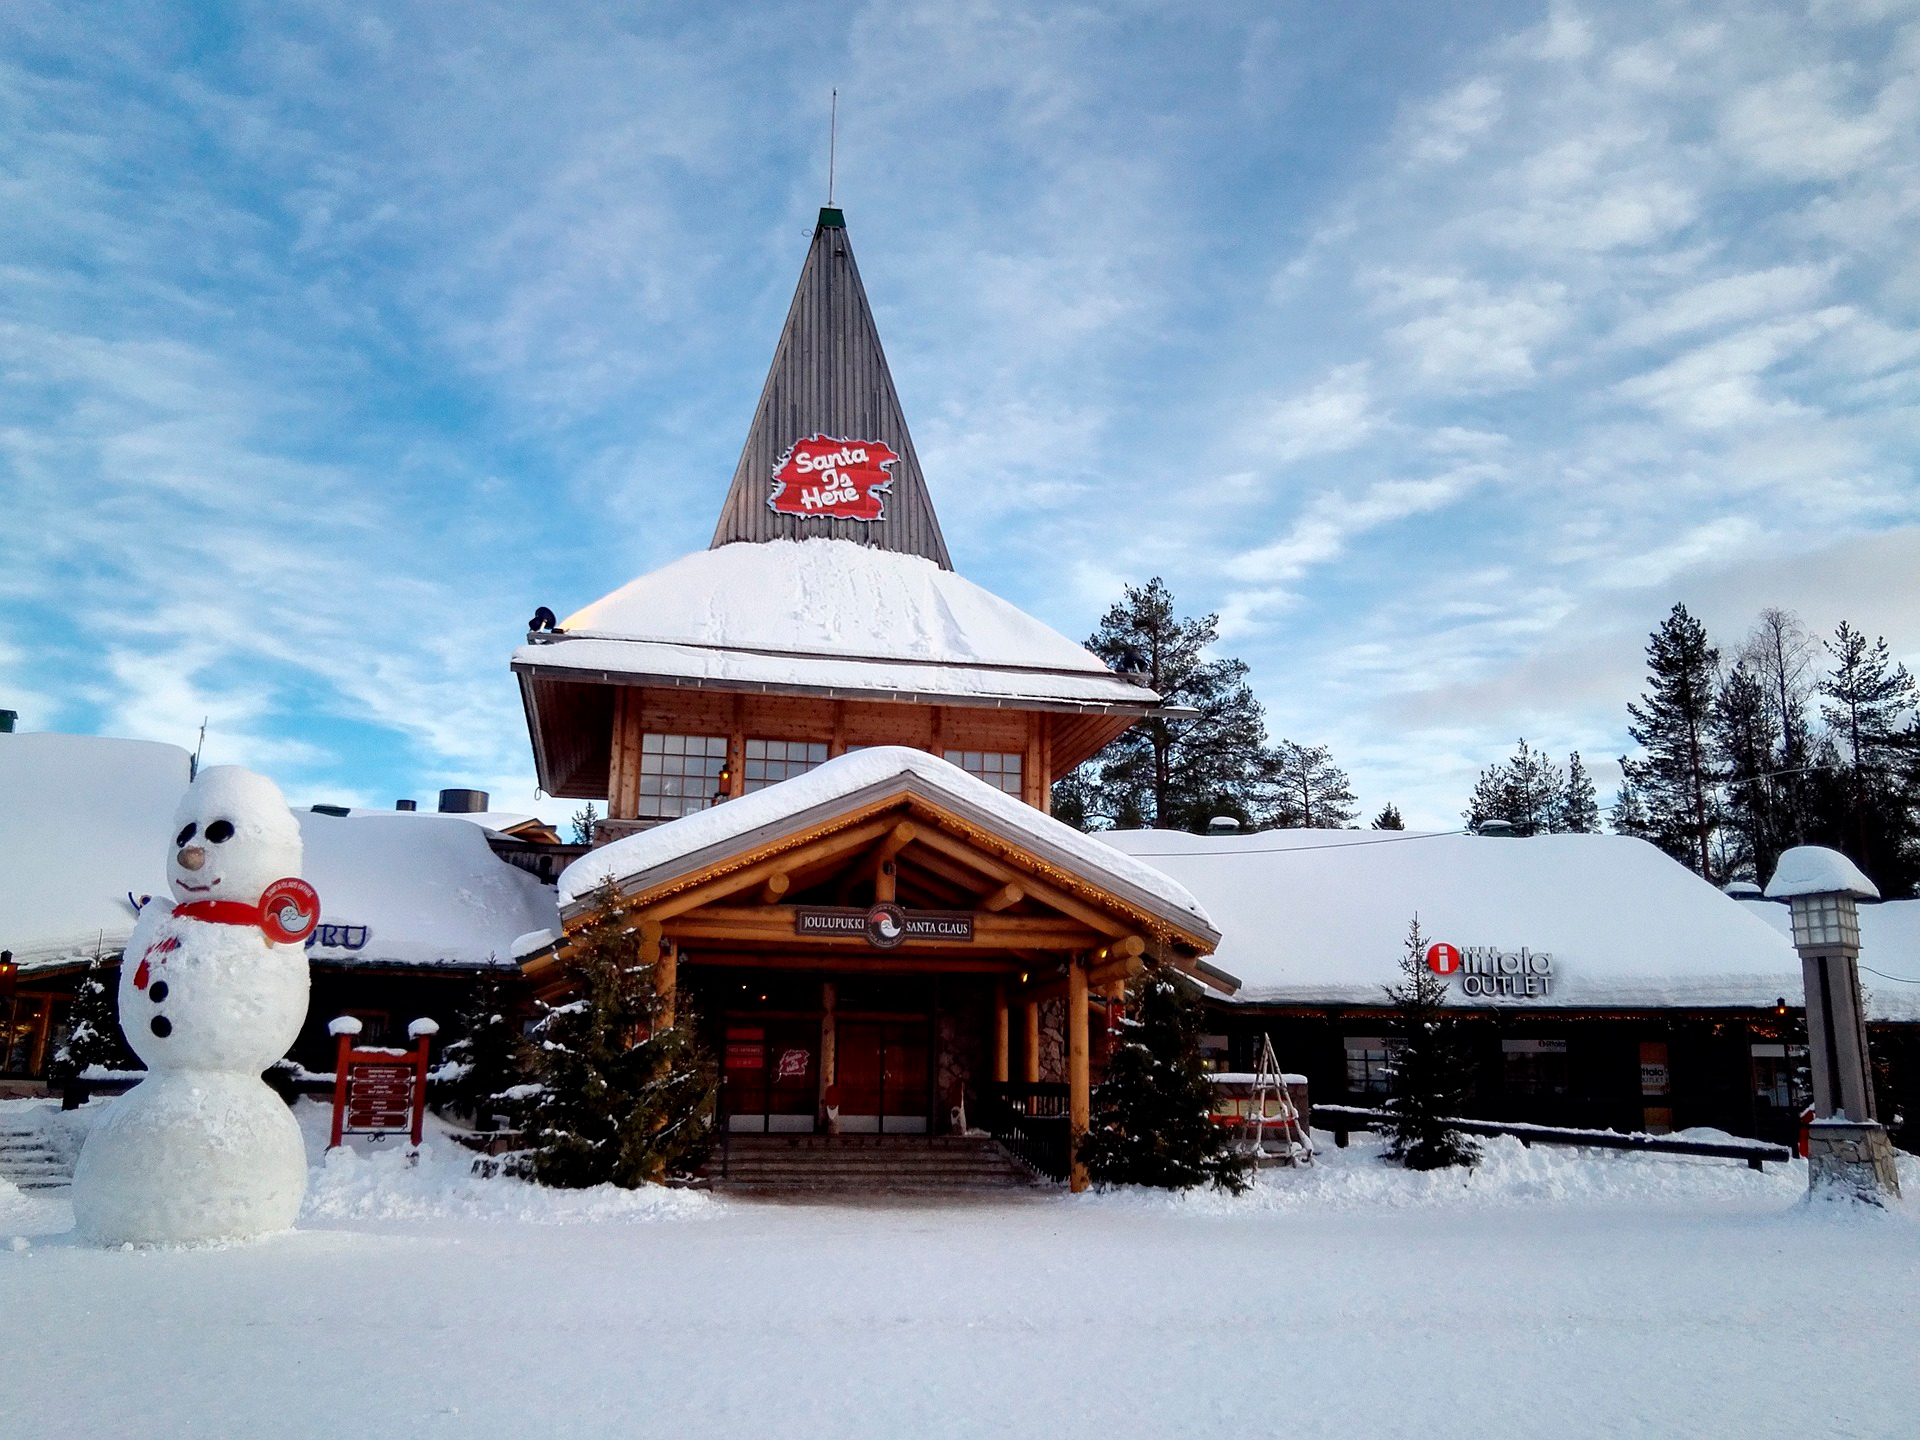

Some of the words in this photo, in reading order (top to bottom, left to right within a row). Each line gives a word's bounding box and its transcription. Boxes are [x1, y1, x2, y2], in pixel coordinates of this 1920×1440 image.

[795, 447, 869, 474] Santa
[821, 468, 853, 491] Is
[801, 486, 860, 510] Here
[804, 916, 865, 930] JOULUPUKKI
[906, 921, 936, 933] SANTA
[938, 922, 968, 934] CLAUS
[1461, 946, 1554, 974] iittala
[1463, 975, 1552, 995] OUTLET
